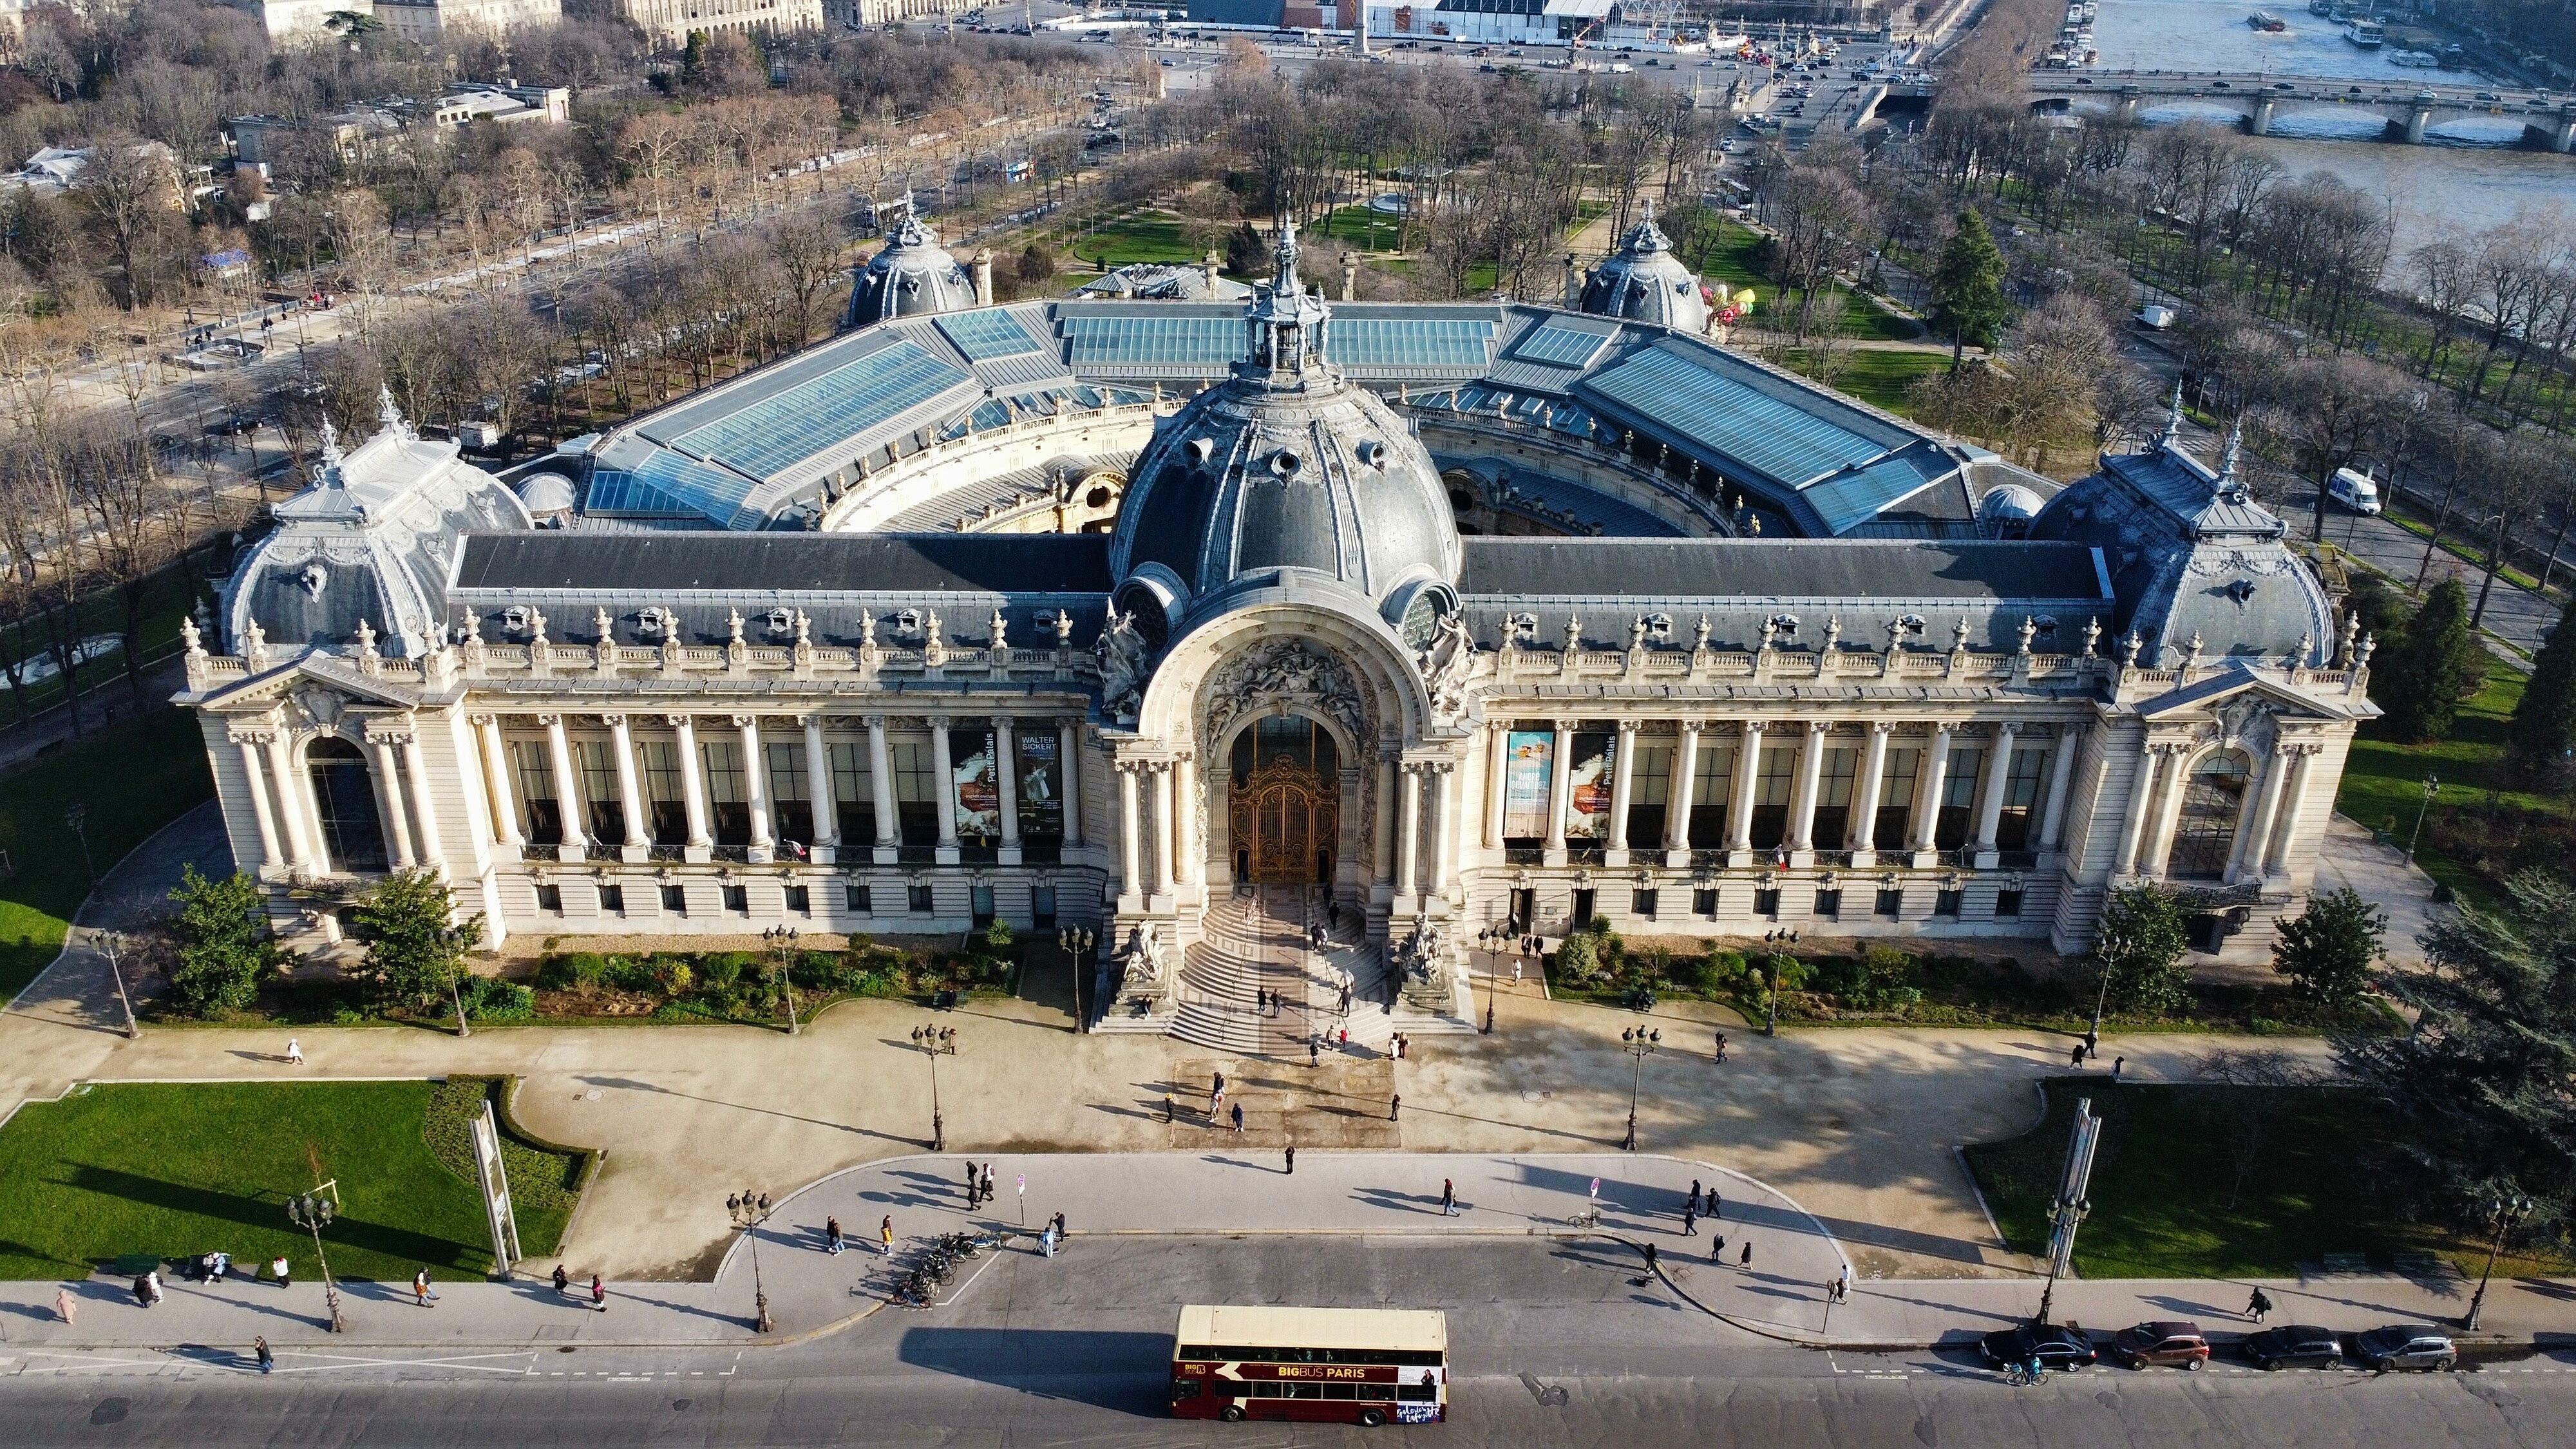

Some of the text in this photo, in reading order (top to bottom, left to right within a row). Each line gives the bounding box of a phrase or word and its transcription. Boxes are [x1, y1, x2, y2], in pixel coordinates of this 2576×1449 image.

[985, 733, 996, 782] Petit Palais
[1604, 762, 1613, 786] Petit
[1327, 1368, 1365, 1378] PARIS
